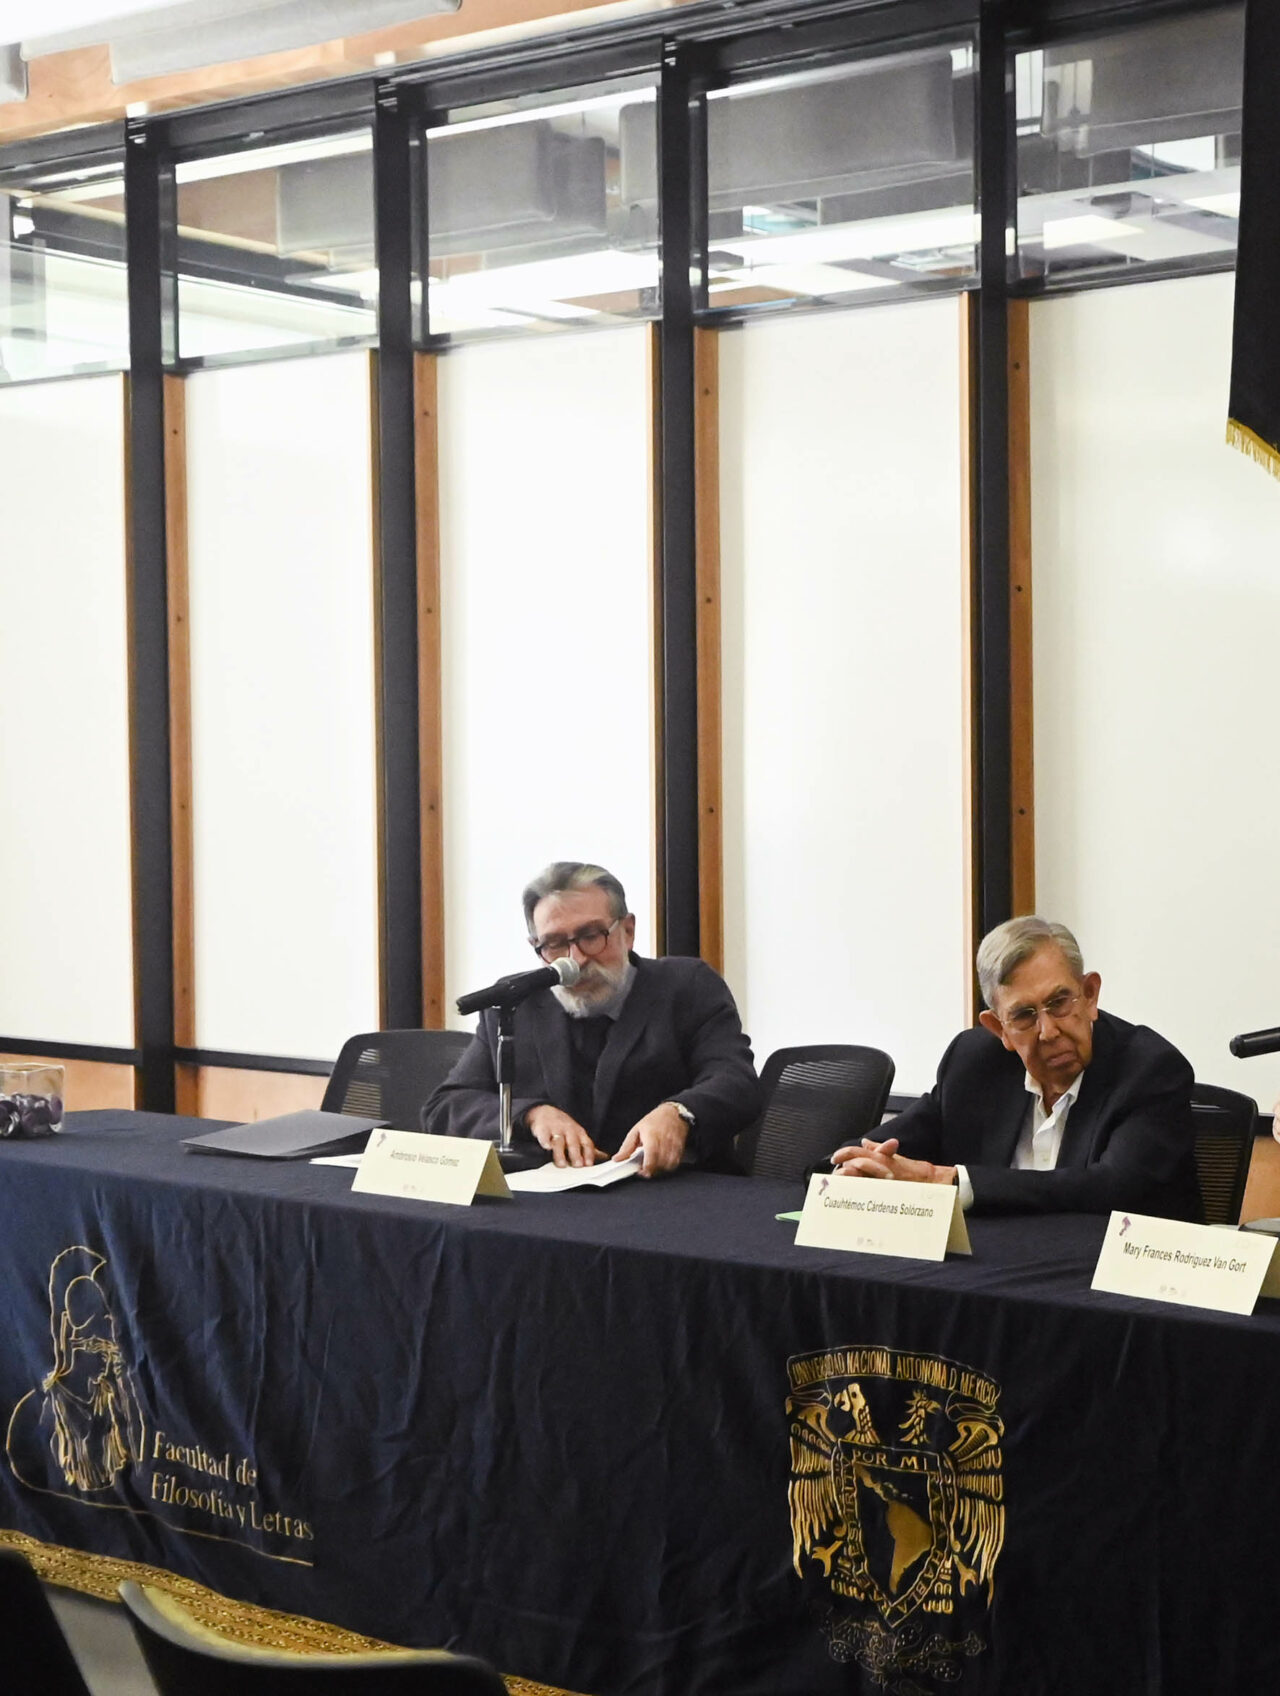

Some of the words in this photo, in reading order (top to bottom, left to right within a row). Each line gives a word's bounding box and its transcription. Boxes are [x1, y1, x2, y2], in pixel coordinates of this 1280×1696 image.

[1122, 1241, 1143, 1260] Mary
[1142, 1244, 1173, 1261] Frances
[1212, 1255, 1228, 1269] Van
[846, 1350, 892, 1376] NACIONAL
[151, 1430, 230, 1481] Facultad
[235, 1457, 258, 1488] de
[851, 1449, 888, 1466] POR
[899, 1455, 928, 1471] MI
[236, 1503, 247, 1529] y
[249, 1500, 315, 1542] Letras
